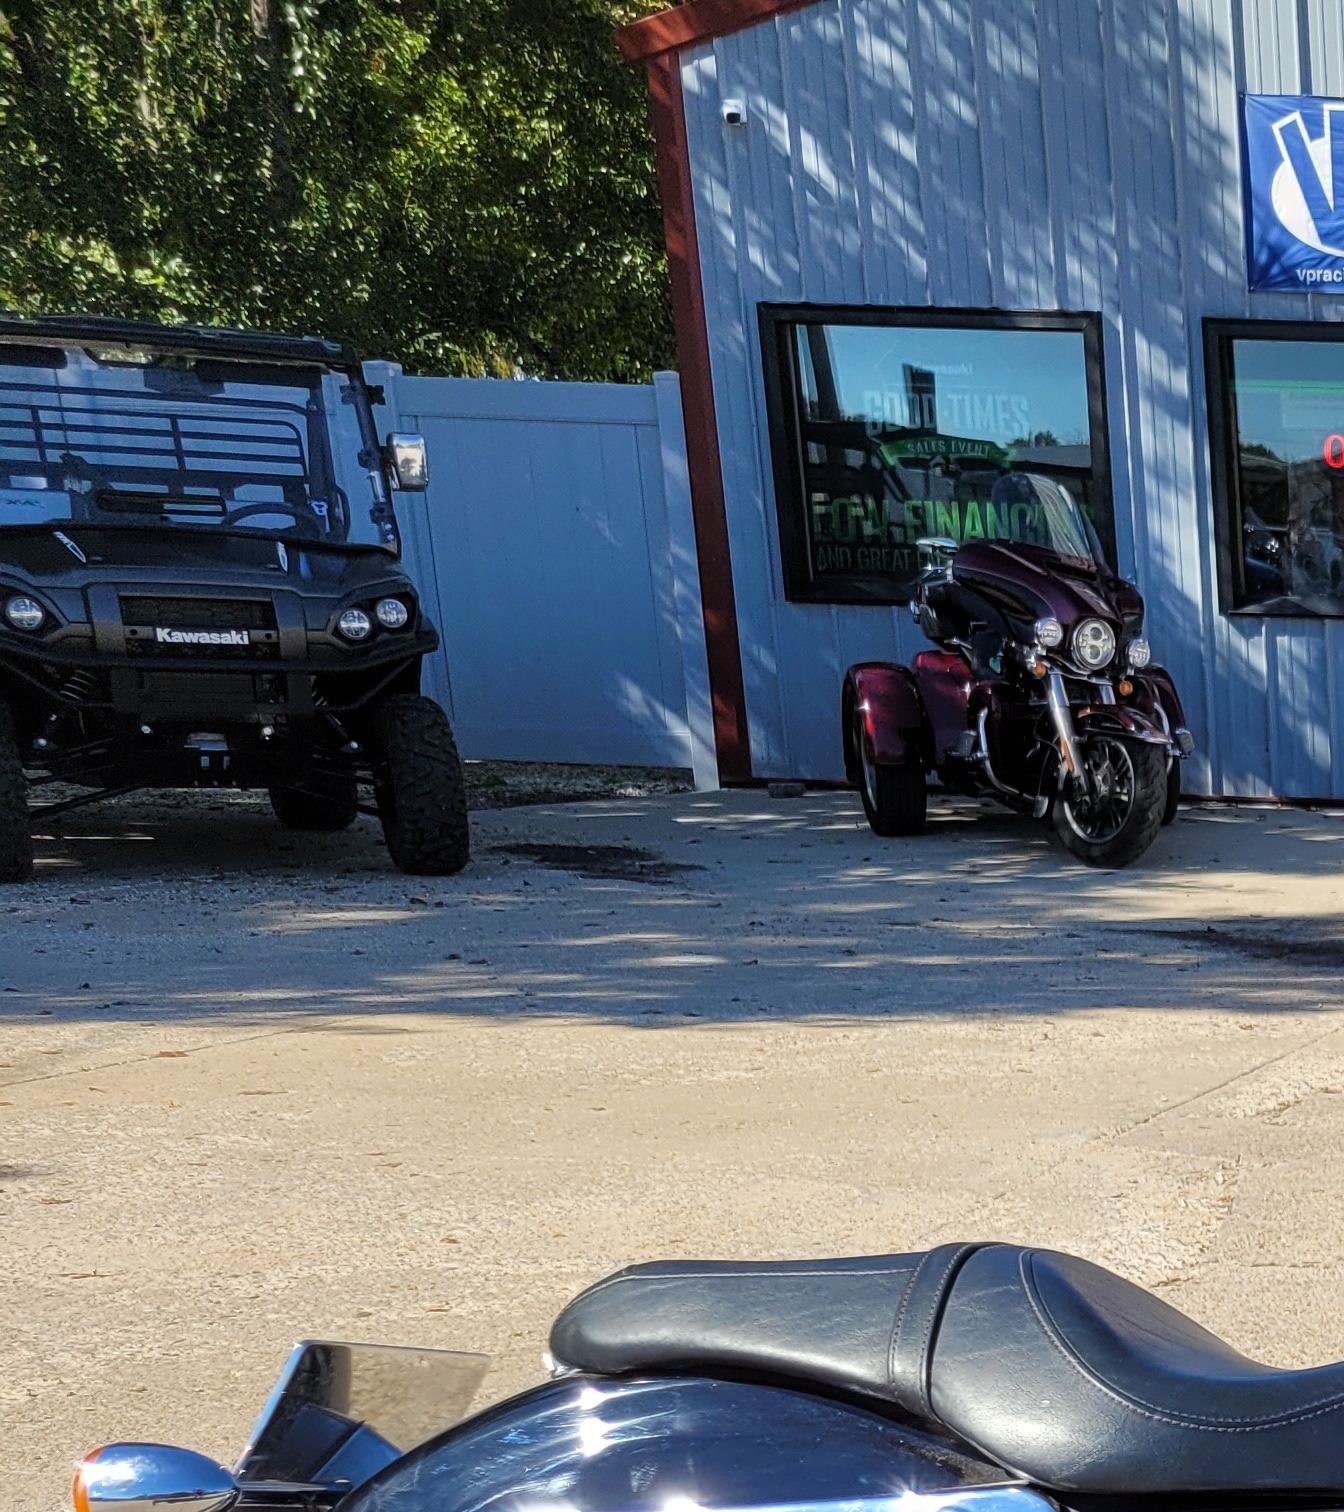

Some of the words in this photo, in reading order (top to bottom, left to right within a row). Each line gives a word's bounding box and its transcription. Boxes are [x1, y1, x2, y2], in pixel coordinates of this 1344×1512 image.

[862, 390, 937, 437] GOOD
[947, 394, 1030, 436] TIMES
[907, 438, 946, 456] SALES
[951, 440, 991, 457] EVENT
[817, 546, 851, 573] AND
[857, 548, 912, 572] GREAT
[155, 628, 250, 645] Kawasaki
